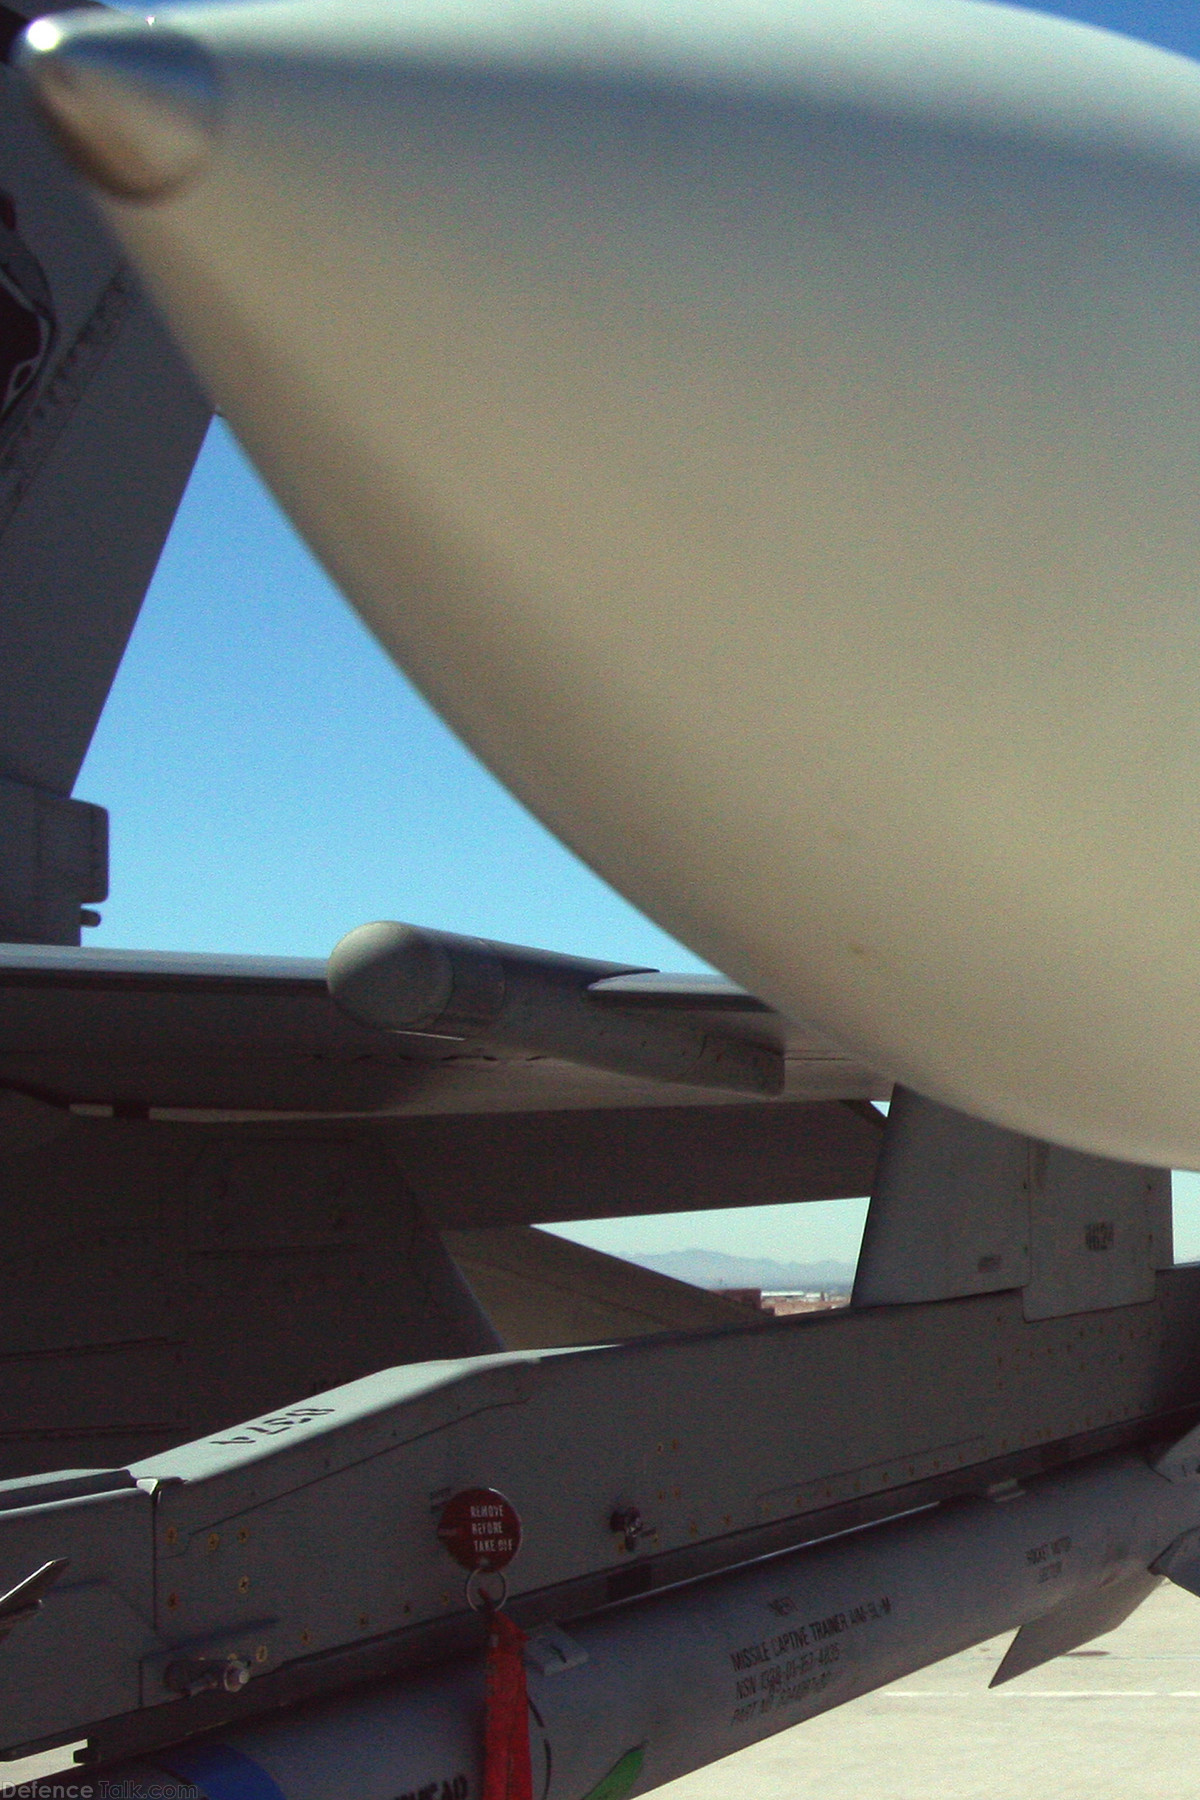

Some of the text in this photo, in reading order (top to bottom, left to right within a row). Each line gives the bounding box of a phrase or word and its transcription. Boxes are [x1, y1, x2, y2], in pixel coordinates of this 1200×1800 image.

[470, 1504, 504, 1518] REMOVE
[471, 1521, 503, 1535] BEFORE
[473, 1539, 496, 1552] TAKE
[730, 1642, 771, 1672] MISSILE
[771, 1626, 810, 1657] CAPTIVE
[808, 1613, 849, 1641] TRAINER
